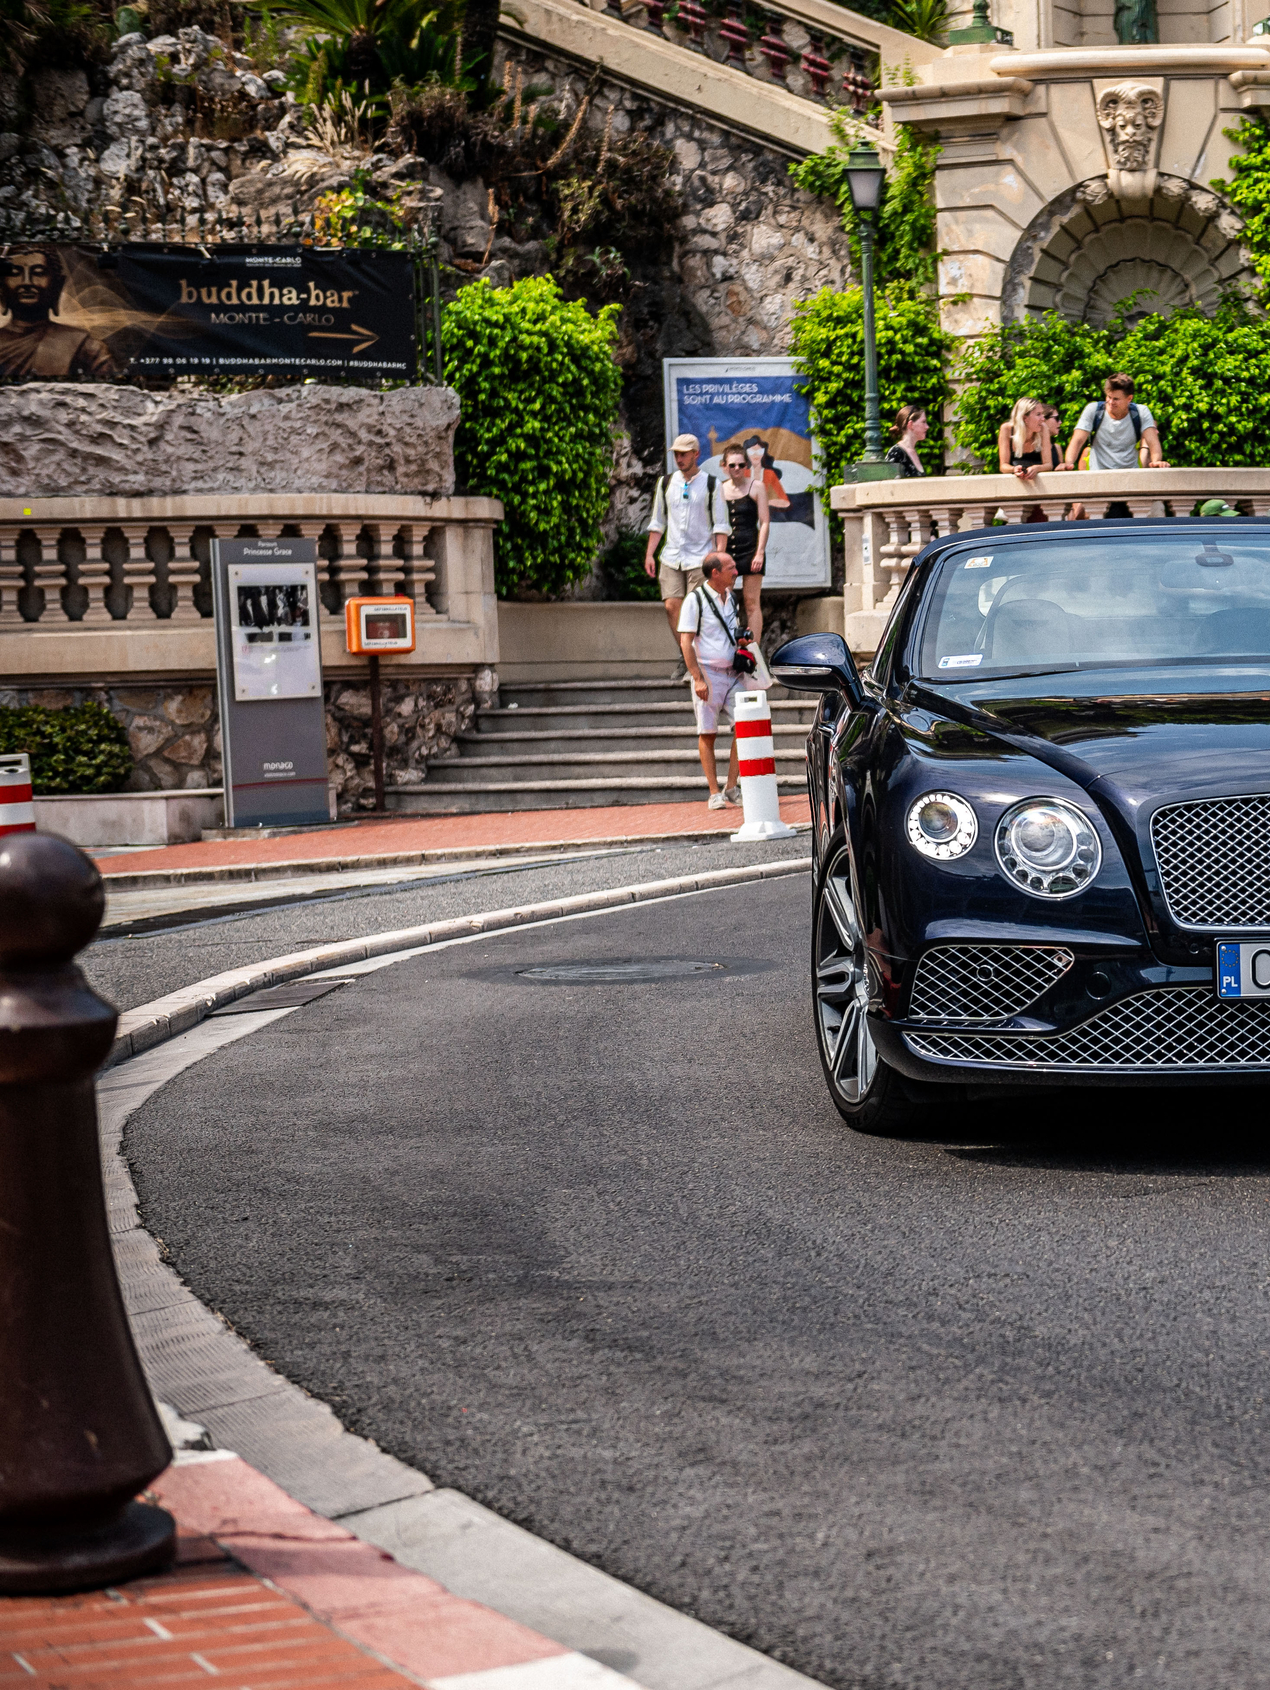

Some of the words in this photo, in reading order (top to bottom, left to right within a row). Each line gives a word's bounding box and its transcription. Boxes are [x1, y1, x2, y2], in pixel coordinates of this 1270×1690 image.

[179, 278, 354, 308] buddha-bar
[211, 312, 270, 325] MONTE
[283, 312, 335, 326] CARLO
[683, 385, 700, 394] LES
[702, 381, 759, 393] PRIVILÈGES
[684, 395, 712, 405] SONT
[713, 395, 726, 404] AU
[727, 393, 793, 404] PROGRAMME
[263, 761, 294, 770] monaco
[1222, 976, 1238, 988] PL
